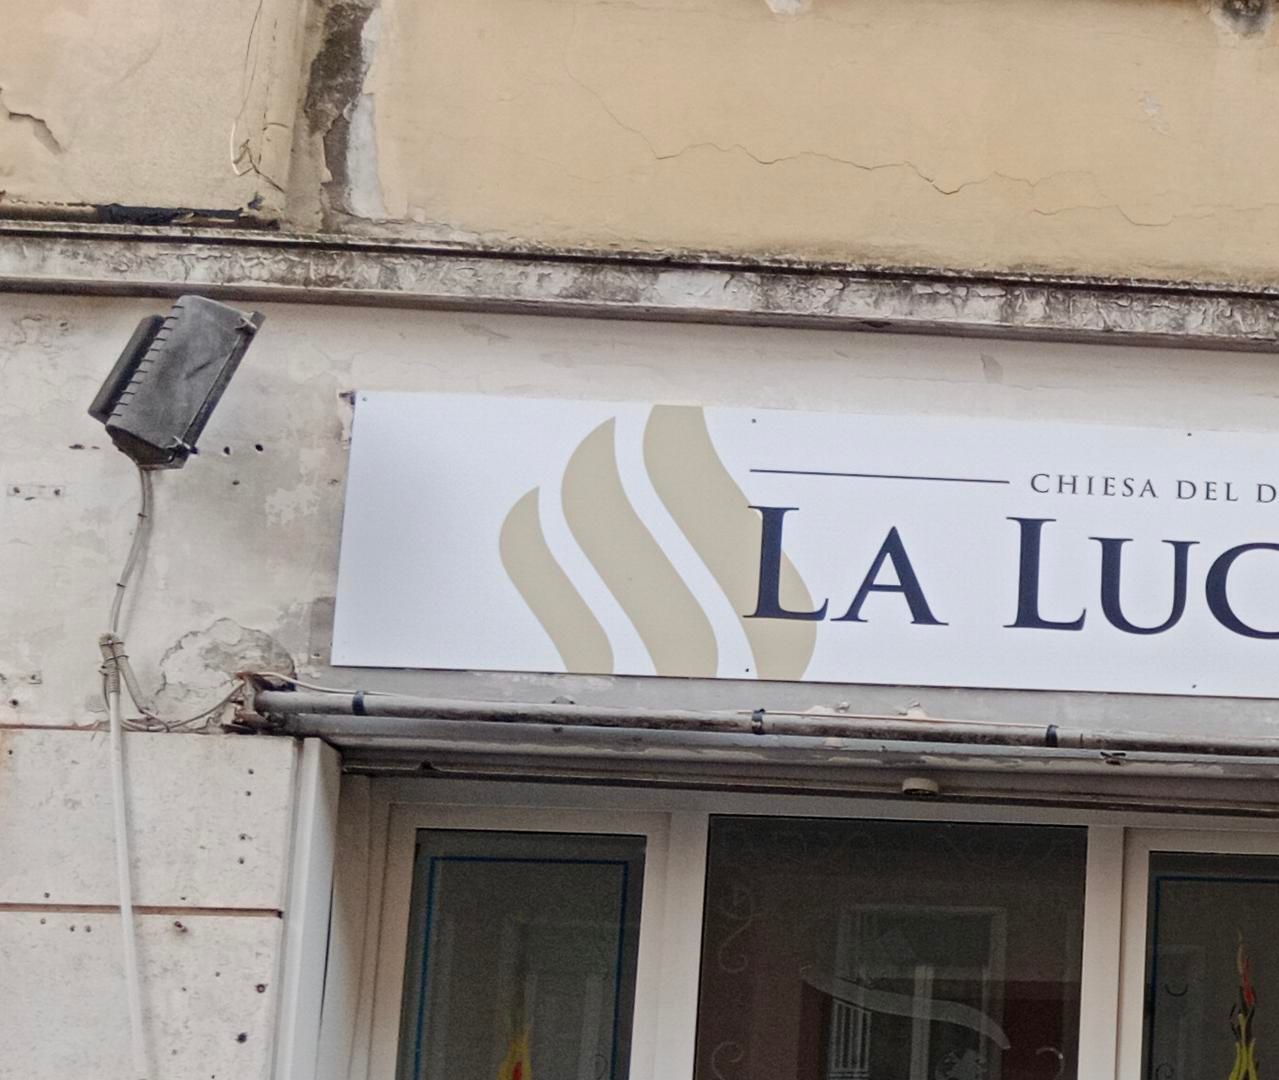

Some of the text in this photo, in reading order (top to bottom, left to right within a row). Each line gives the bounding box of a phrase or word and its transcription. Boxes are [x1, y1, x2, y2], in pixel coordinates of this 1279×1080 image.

[1029, 472, 1159, 499] CHIESA
[1176, 479, 1239, 503] DEL
[742, 504, 950, 627] LA
